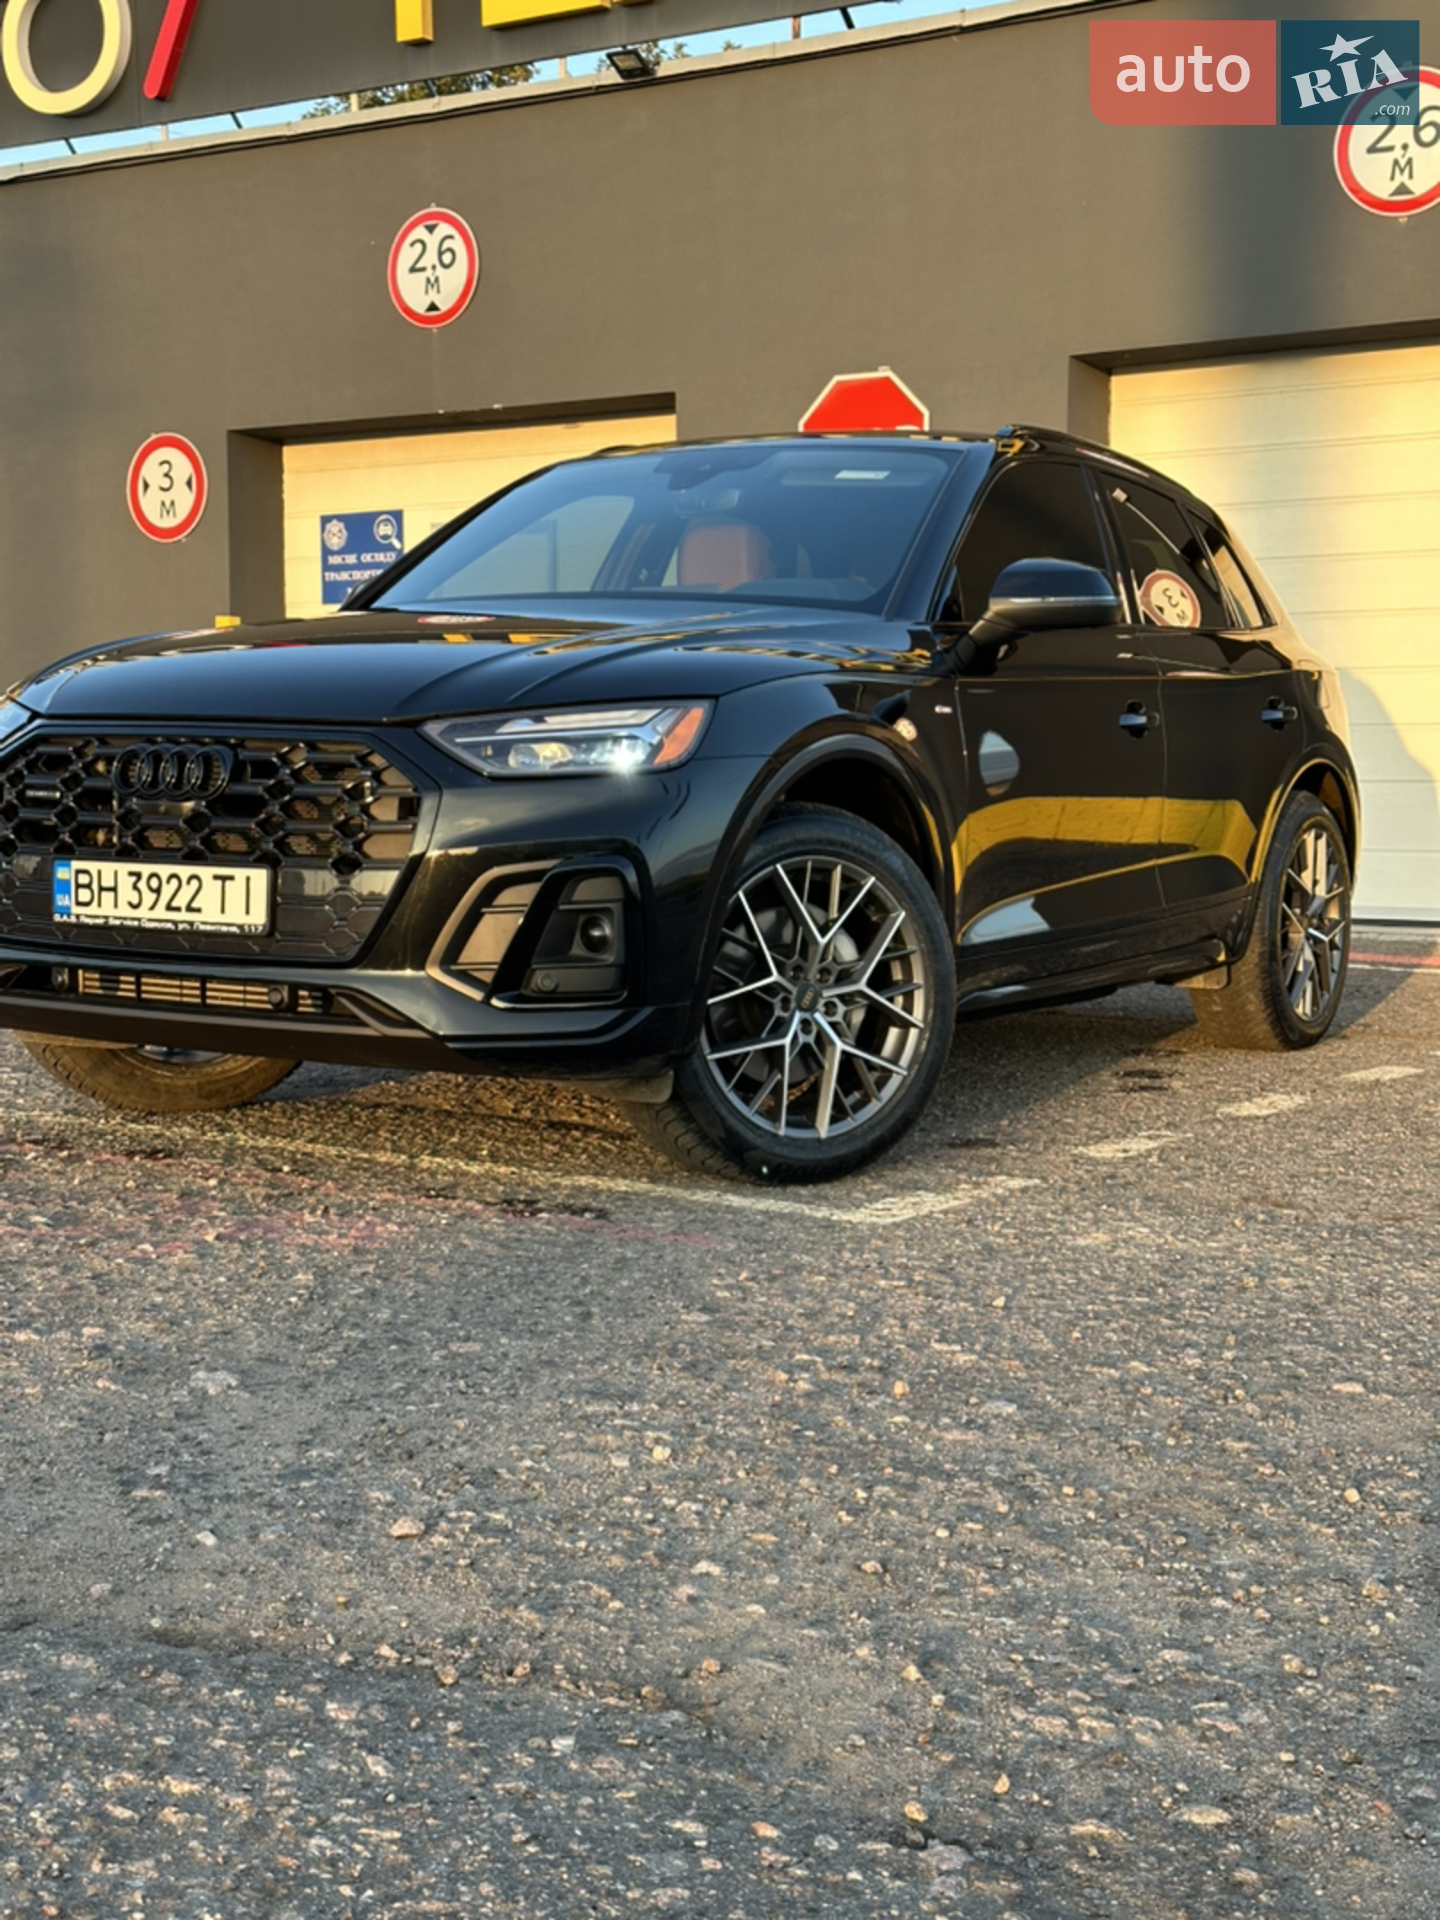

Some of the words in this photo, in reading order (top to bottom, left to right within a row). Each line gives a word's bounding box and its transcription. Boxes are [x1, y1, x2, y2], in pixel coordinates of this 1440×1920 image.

[408, 234, 456, 276] 2,6
[158, 459, 174, 492] 3
[56, 894, 70, 907] UA
[74, 869, 118, 909] BH
[126, 870, 203, 914] 3922
[212, 874, 251, 916] TI
